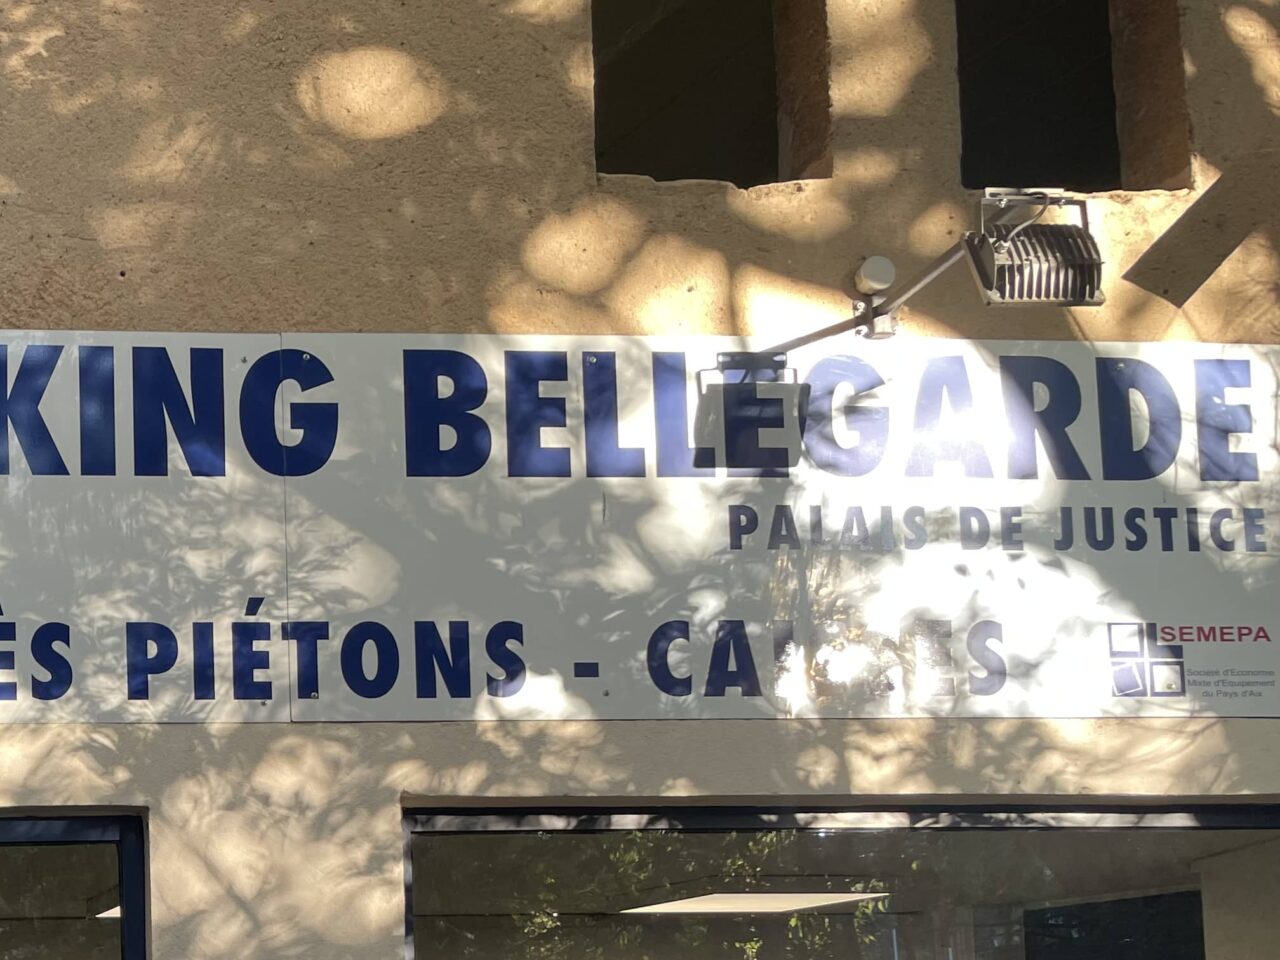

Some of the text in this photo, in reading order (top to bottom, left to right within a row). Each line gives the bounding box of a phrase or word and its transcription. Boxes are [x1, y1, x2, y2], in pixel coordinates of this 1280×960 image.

[403, 349, 1260, 483] BELLEGARDE
[728, 504, 1267, 553] PALAIS DE JUSTICE
[126, 597, 527, 700] PIÉTONS
[646, 619, 1008, 698] CAES
[1160, 626, 1272, 643] SEMEPA
[1187, 679, 1212, 688] Mixte
[1202, 690, 1263, 699] du Pays d'Aix
